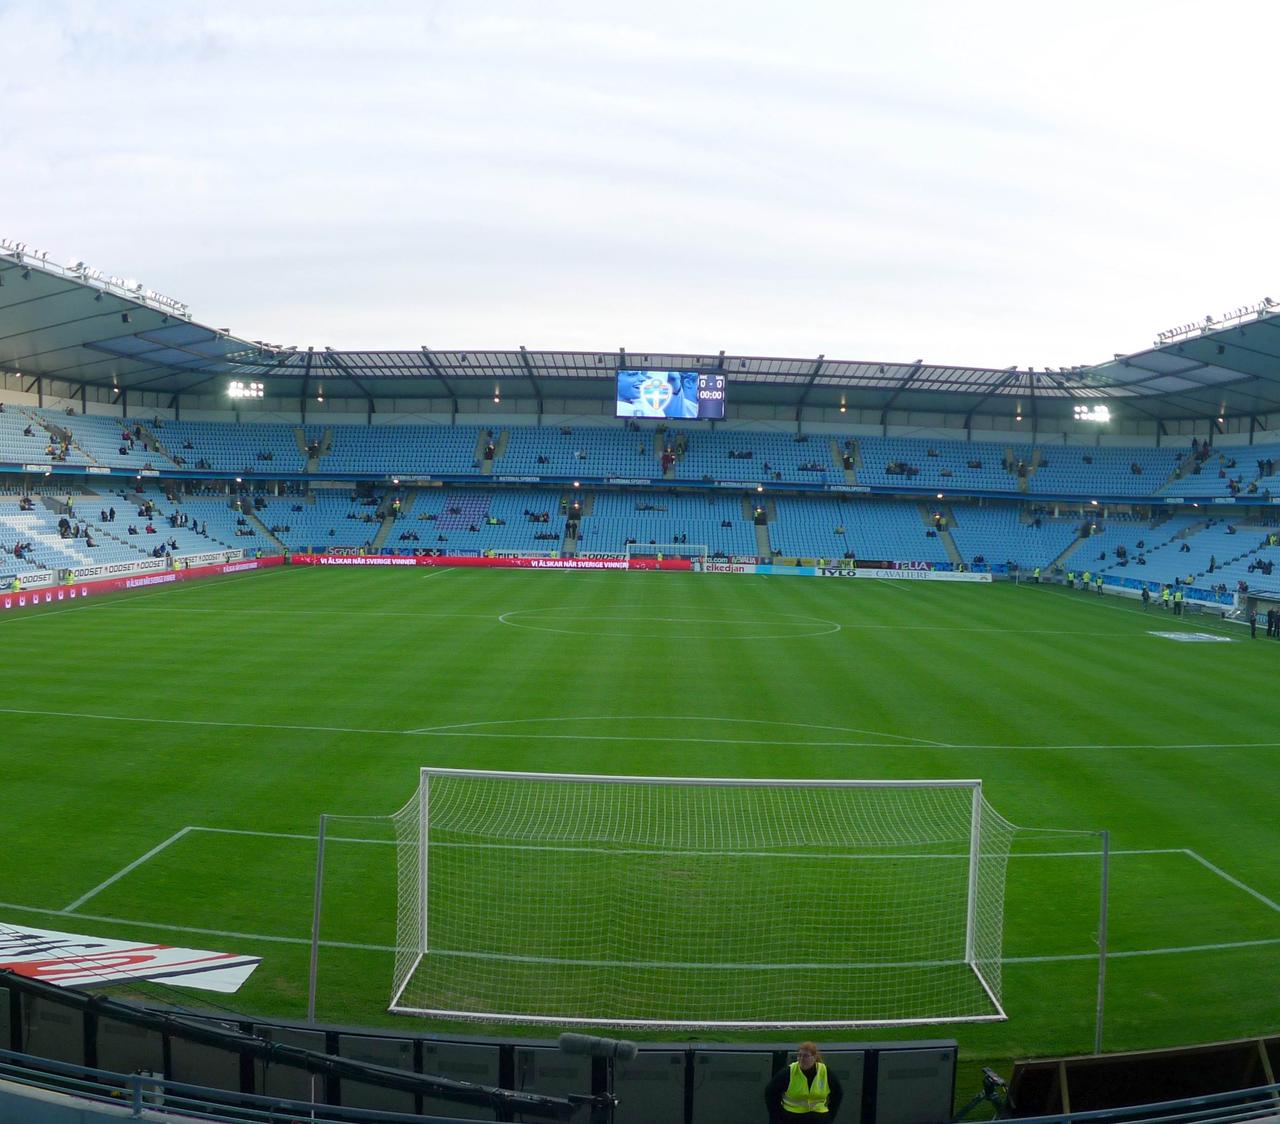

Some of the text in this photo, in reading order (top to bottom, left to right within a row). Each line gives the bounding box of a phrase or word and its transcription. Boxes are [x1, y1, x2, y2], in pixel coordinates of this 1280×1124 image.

[717, 380, 722, 388] 0
[700, 391, 722, 399] 00:00
[328, 546, 361, 556] Scandi
[539, 559, 563, 567] ÄLSKAR
[74, 560, 165, 577] ODDSET ODDSET ODDSET
[22, 573, 52, 584] ODDSET
